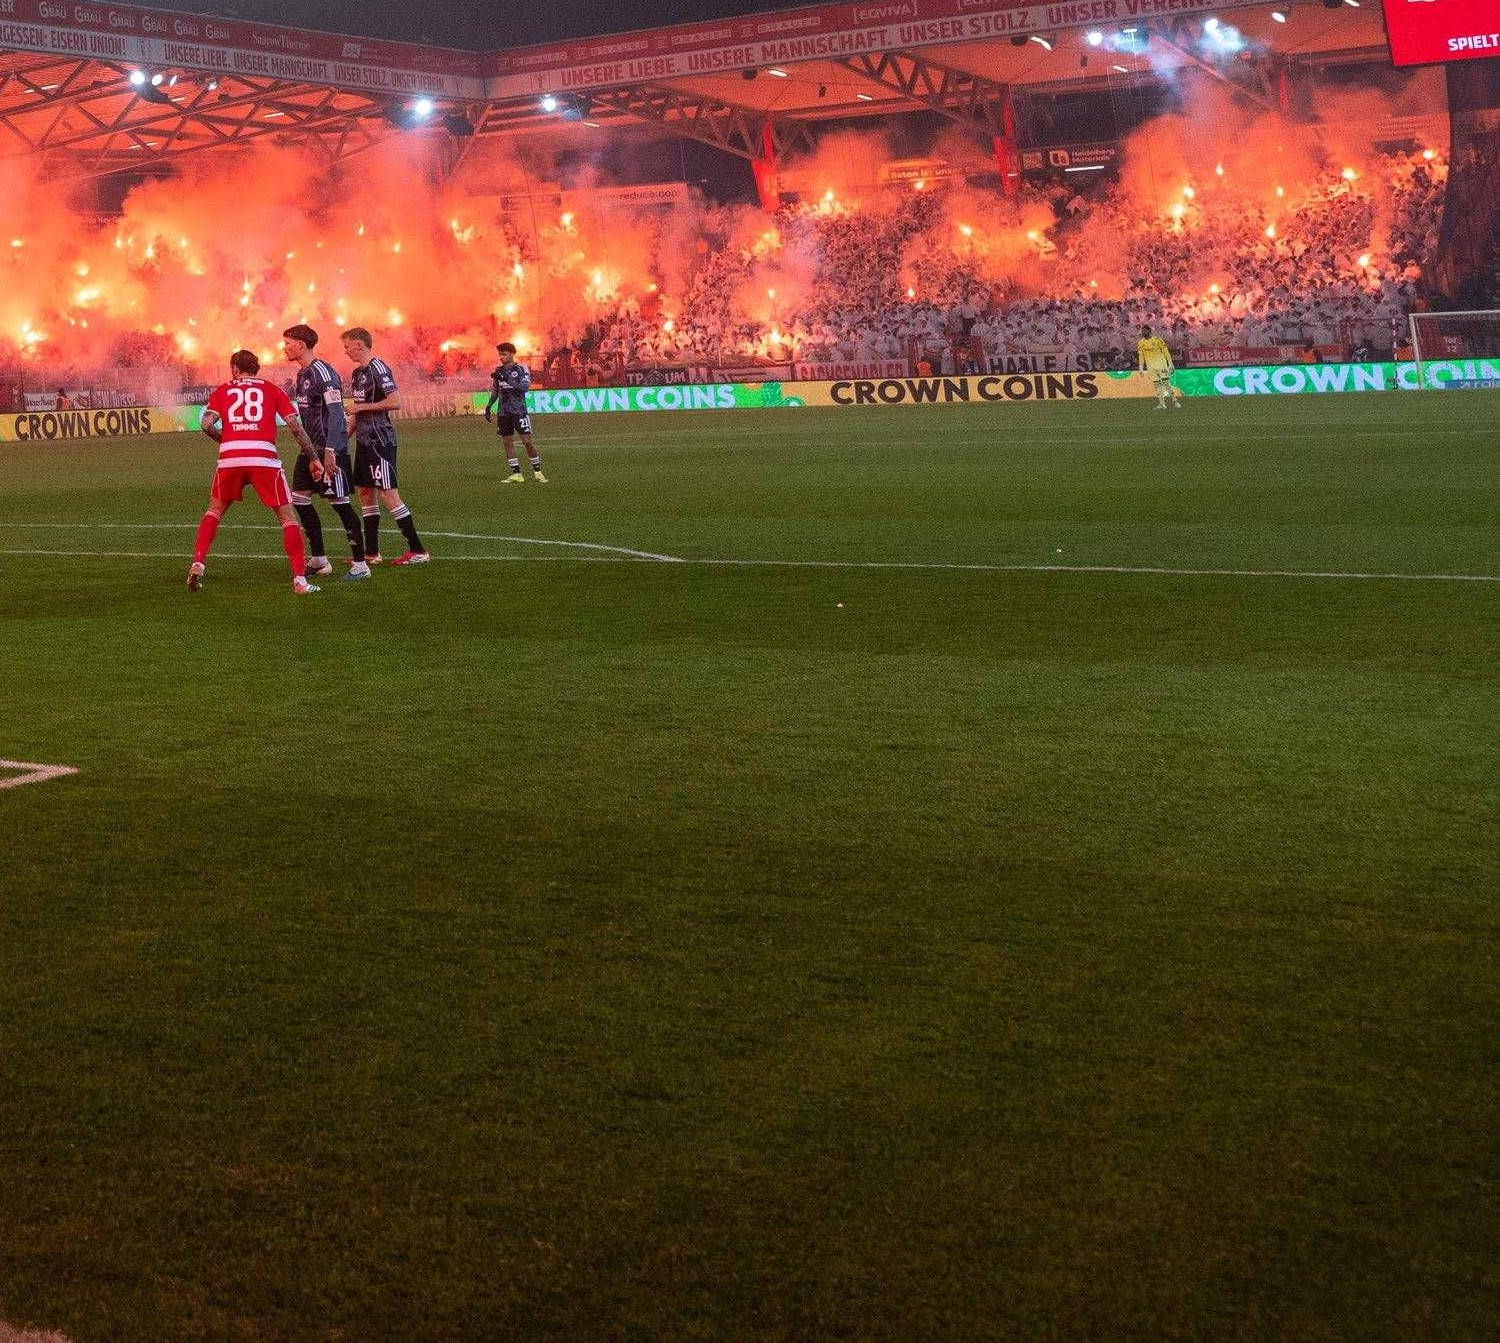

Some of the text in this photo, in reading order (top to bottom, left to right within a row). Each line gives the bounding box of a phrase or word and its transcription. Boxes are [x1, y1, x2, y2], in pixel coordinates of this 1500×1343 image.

[51, 31, 87, 52] EISERN
[89, 36, 127, 57] UNION!
[560, 63, 625, 88] UNSERE
[628, 54, 680, 80] LIEBE.
[687, 45, 755, 72] UNSERE
[761, 28, 893, 62] MANNSCHAFT.
[899, 16, 965, 45] UNSER
[968, 8, 1037, 36] STOLZ.
[1447, 33, 1500, 51] SPIELT
[163, 43, 200, 64] UNSERE
[202, 47, 230, 68] LIEBE.
[233, 52, 269, 73] UNSERE
[271, 58, 330, 81] MANNSCHAFT.
[334, 64, 362, 85] UNSER
[830, 373, 1099, 406] CROWN COINS
[1213, 364, 1385, 395] CROWN
[226, 387, 265, 424] 28
[524, 384, 736, 414] CROWN COINS
[14, 408, 151, 441] CROWN COINS
[519, 418, 529, 428] 21
[369, 464, 382, 480] 16
